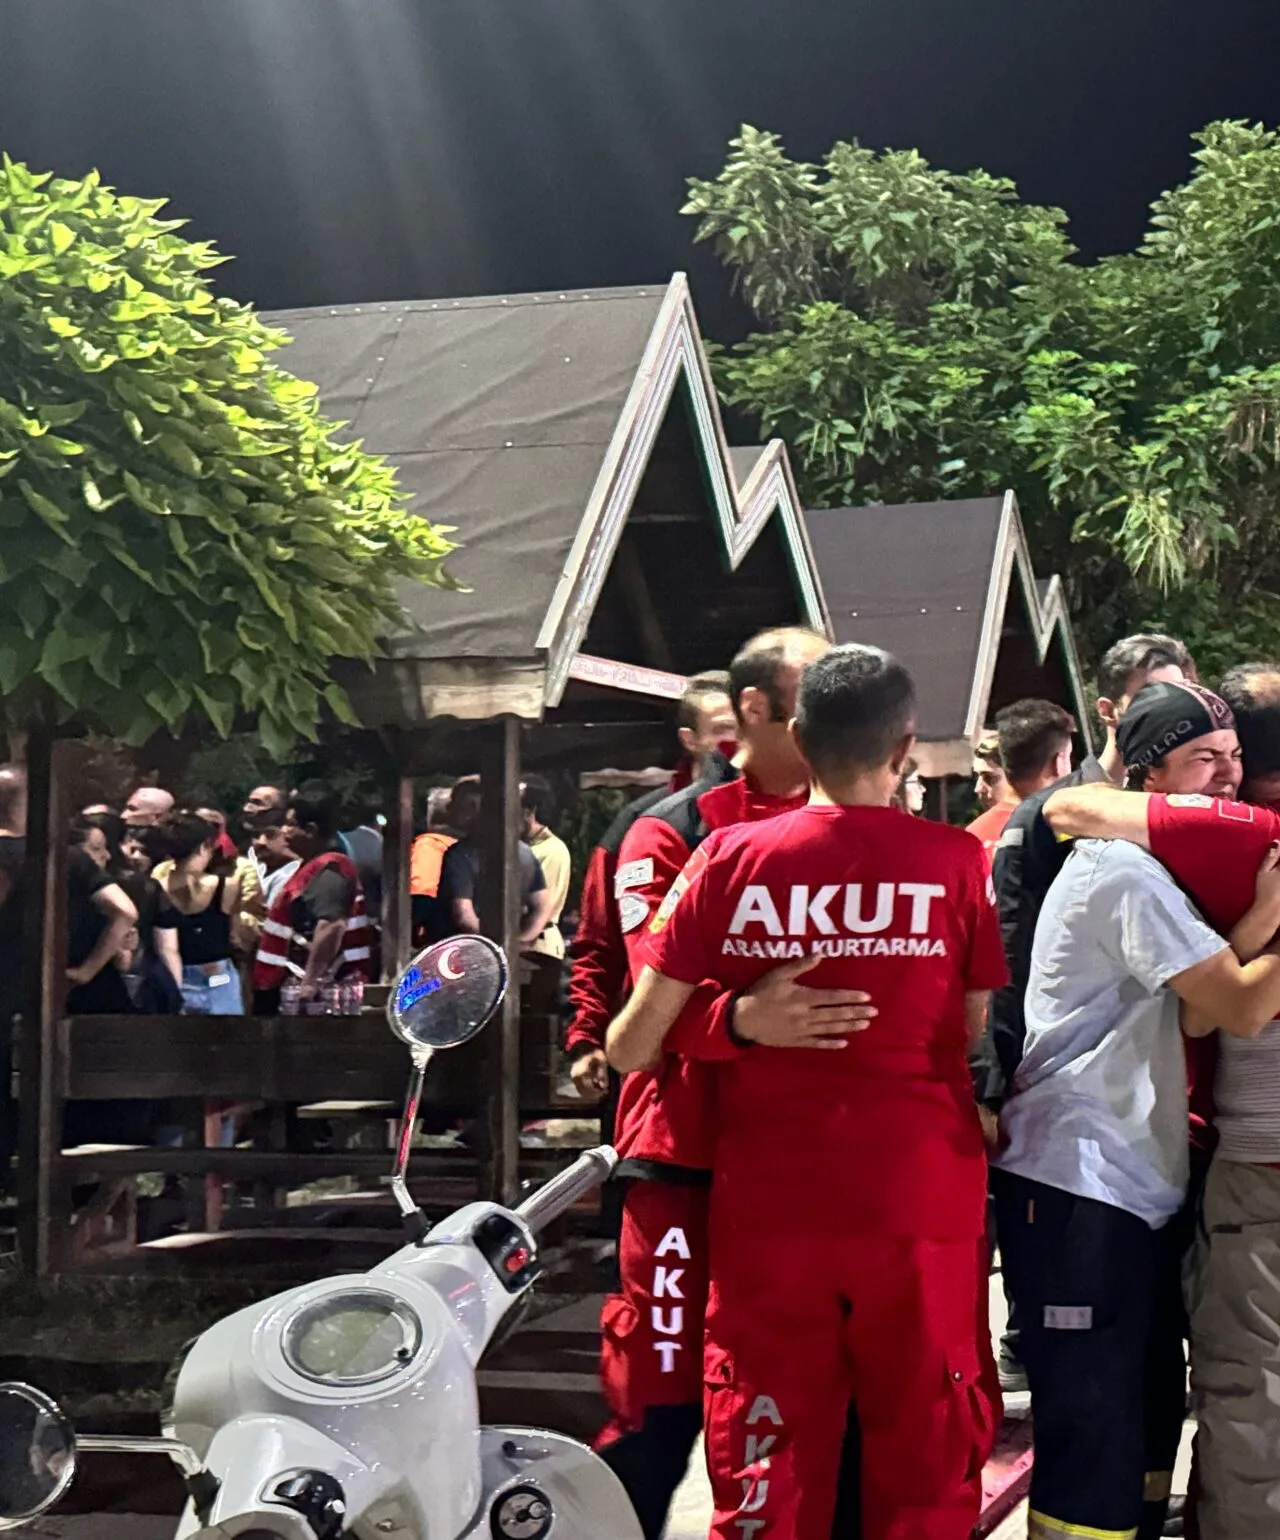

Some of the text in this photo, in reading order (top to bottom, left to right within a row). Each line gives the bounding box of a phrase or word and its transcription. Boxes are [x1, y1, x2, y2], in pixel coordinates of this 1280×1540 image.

[721, 937, 948, 959] ARAMA KURTARMA
[727, 883, 946, 936] AKUT
[651, 1226, 692, 1374] AKUT
[733, 1394, 785, 1540] AKUT
